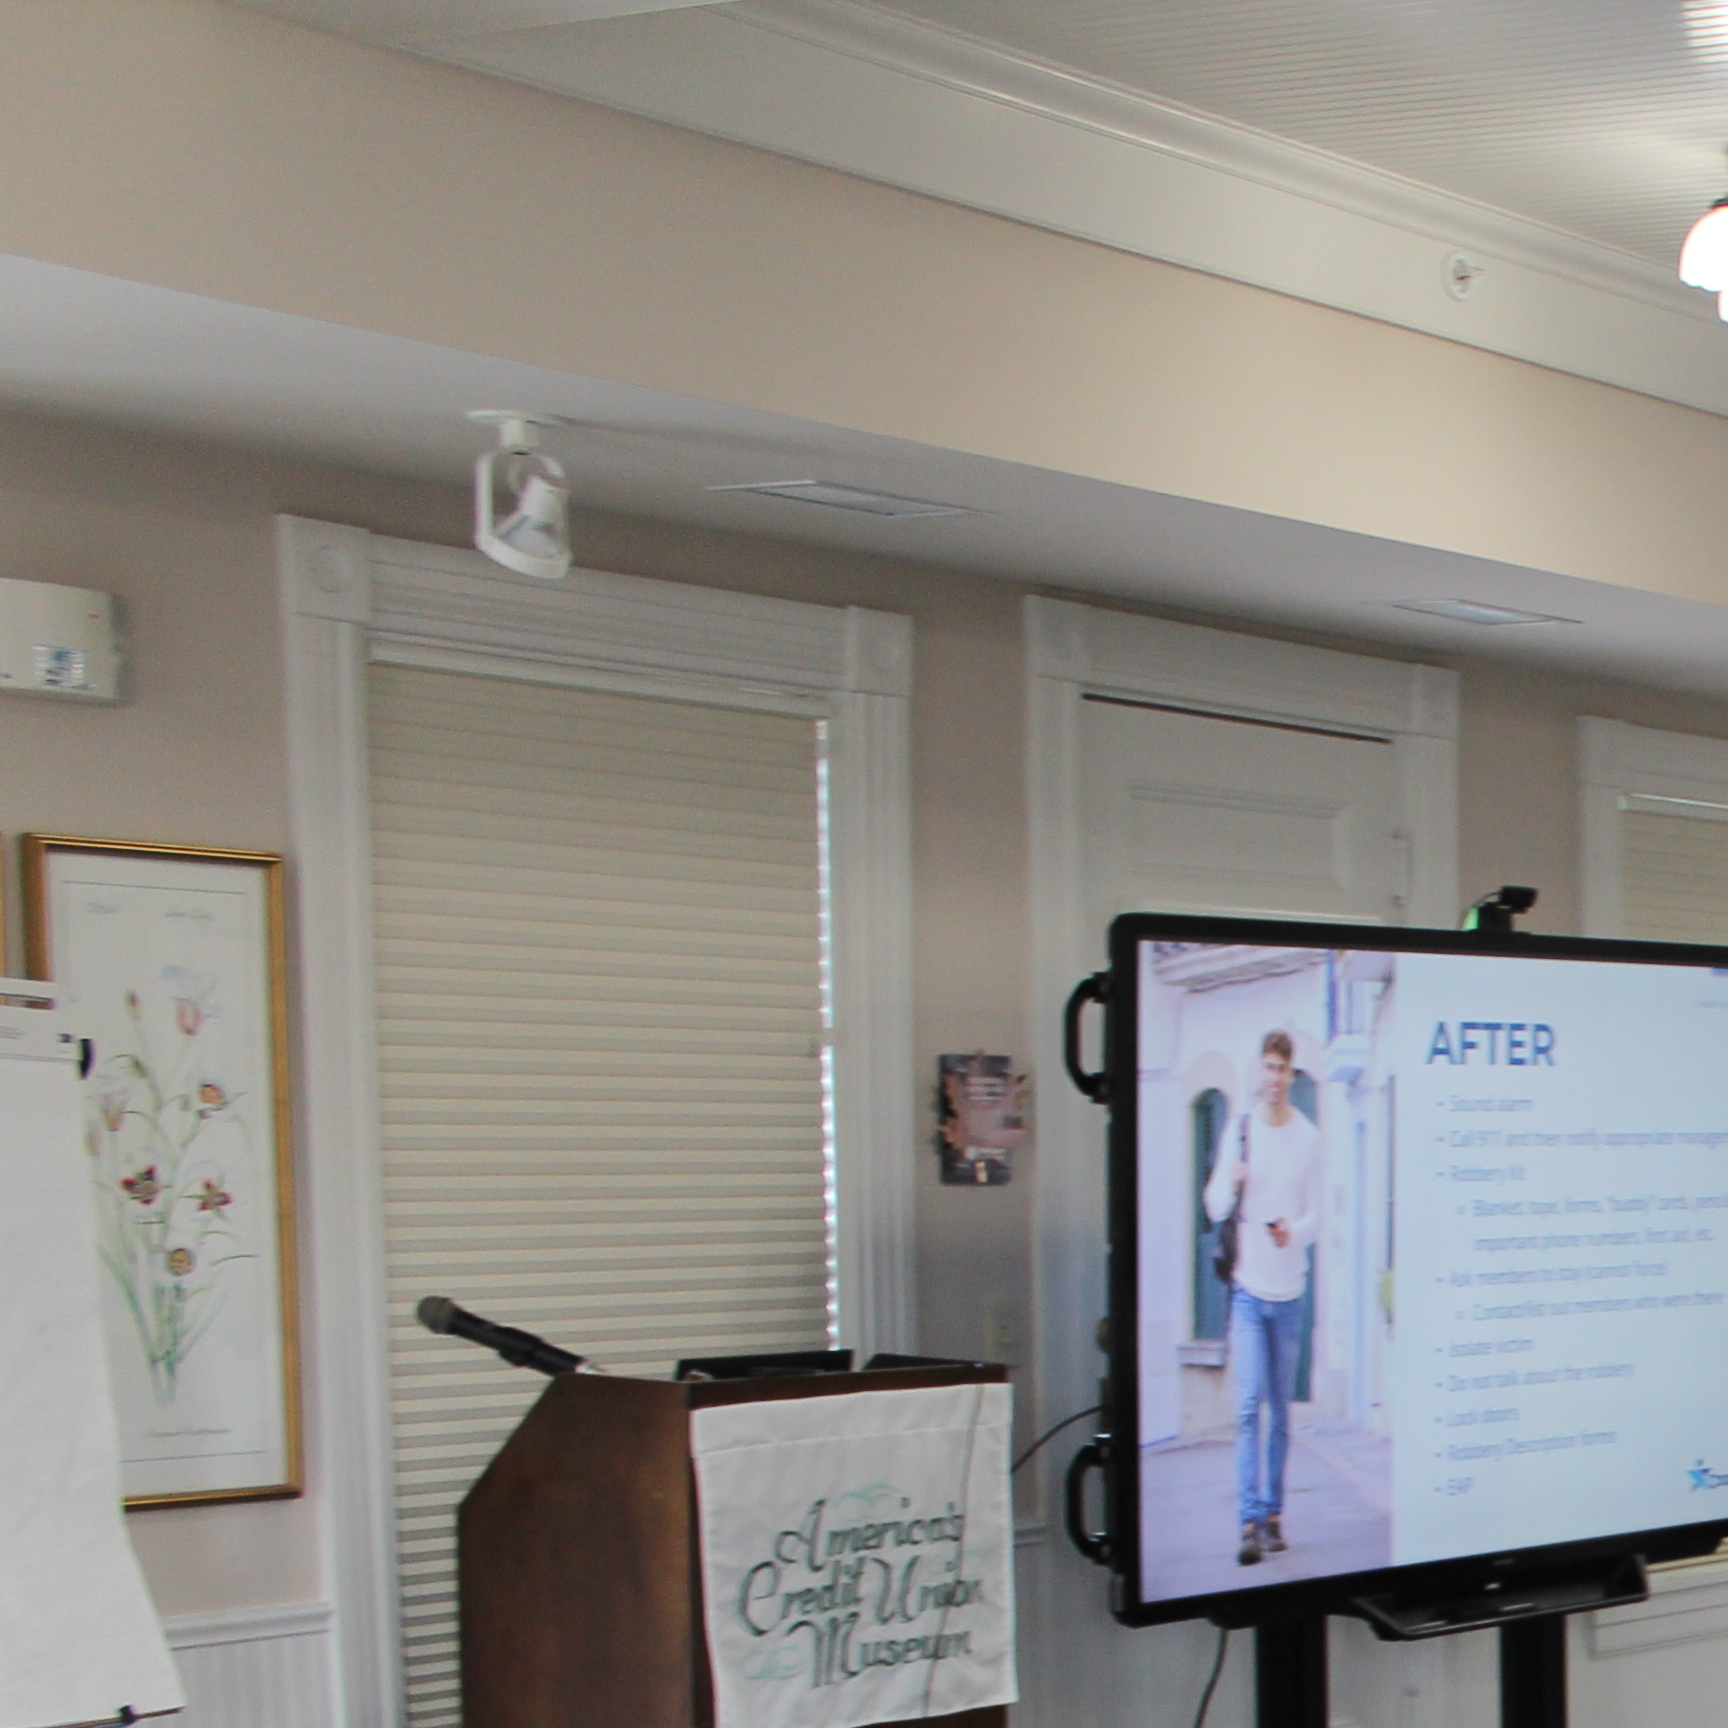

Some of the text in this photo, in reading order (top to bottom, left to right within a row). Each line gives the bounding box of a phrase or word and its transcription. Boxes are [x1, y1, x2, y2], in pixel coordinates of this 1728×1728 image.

[1425, 1020, 1557, 1066] AFTER
[736, 1554, 984, 1638] Credit Union
[783, 1611, 974, 1689] Museum
